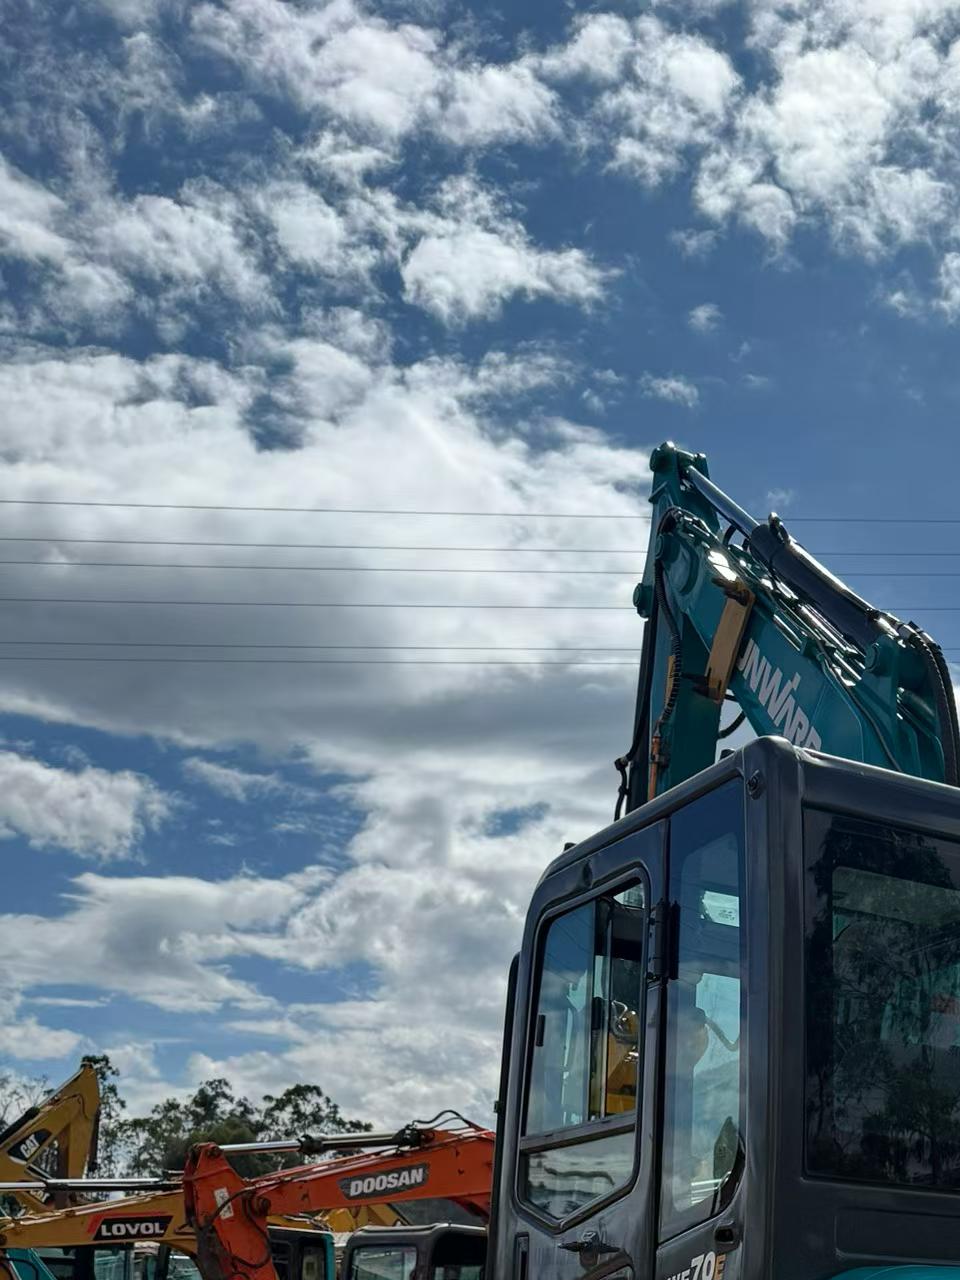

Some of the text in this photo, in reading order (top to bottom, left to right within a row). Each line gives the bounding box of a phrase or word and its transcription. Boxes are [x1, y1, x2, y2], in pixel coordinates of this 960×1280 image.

[20, 1134, 40, 1158] CAT
[350, 1168, 424, 1197] DOOSAN
[101, 1222, 164, 1236] LOVOL
